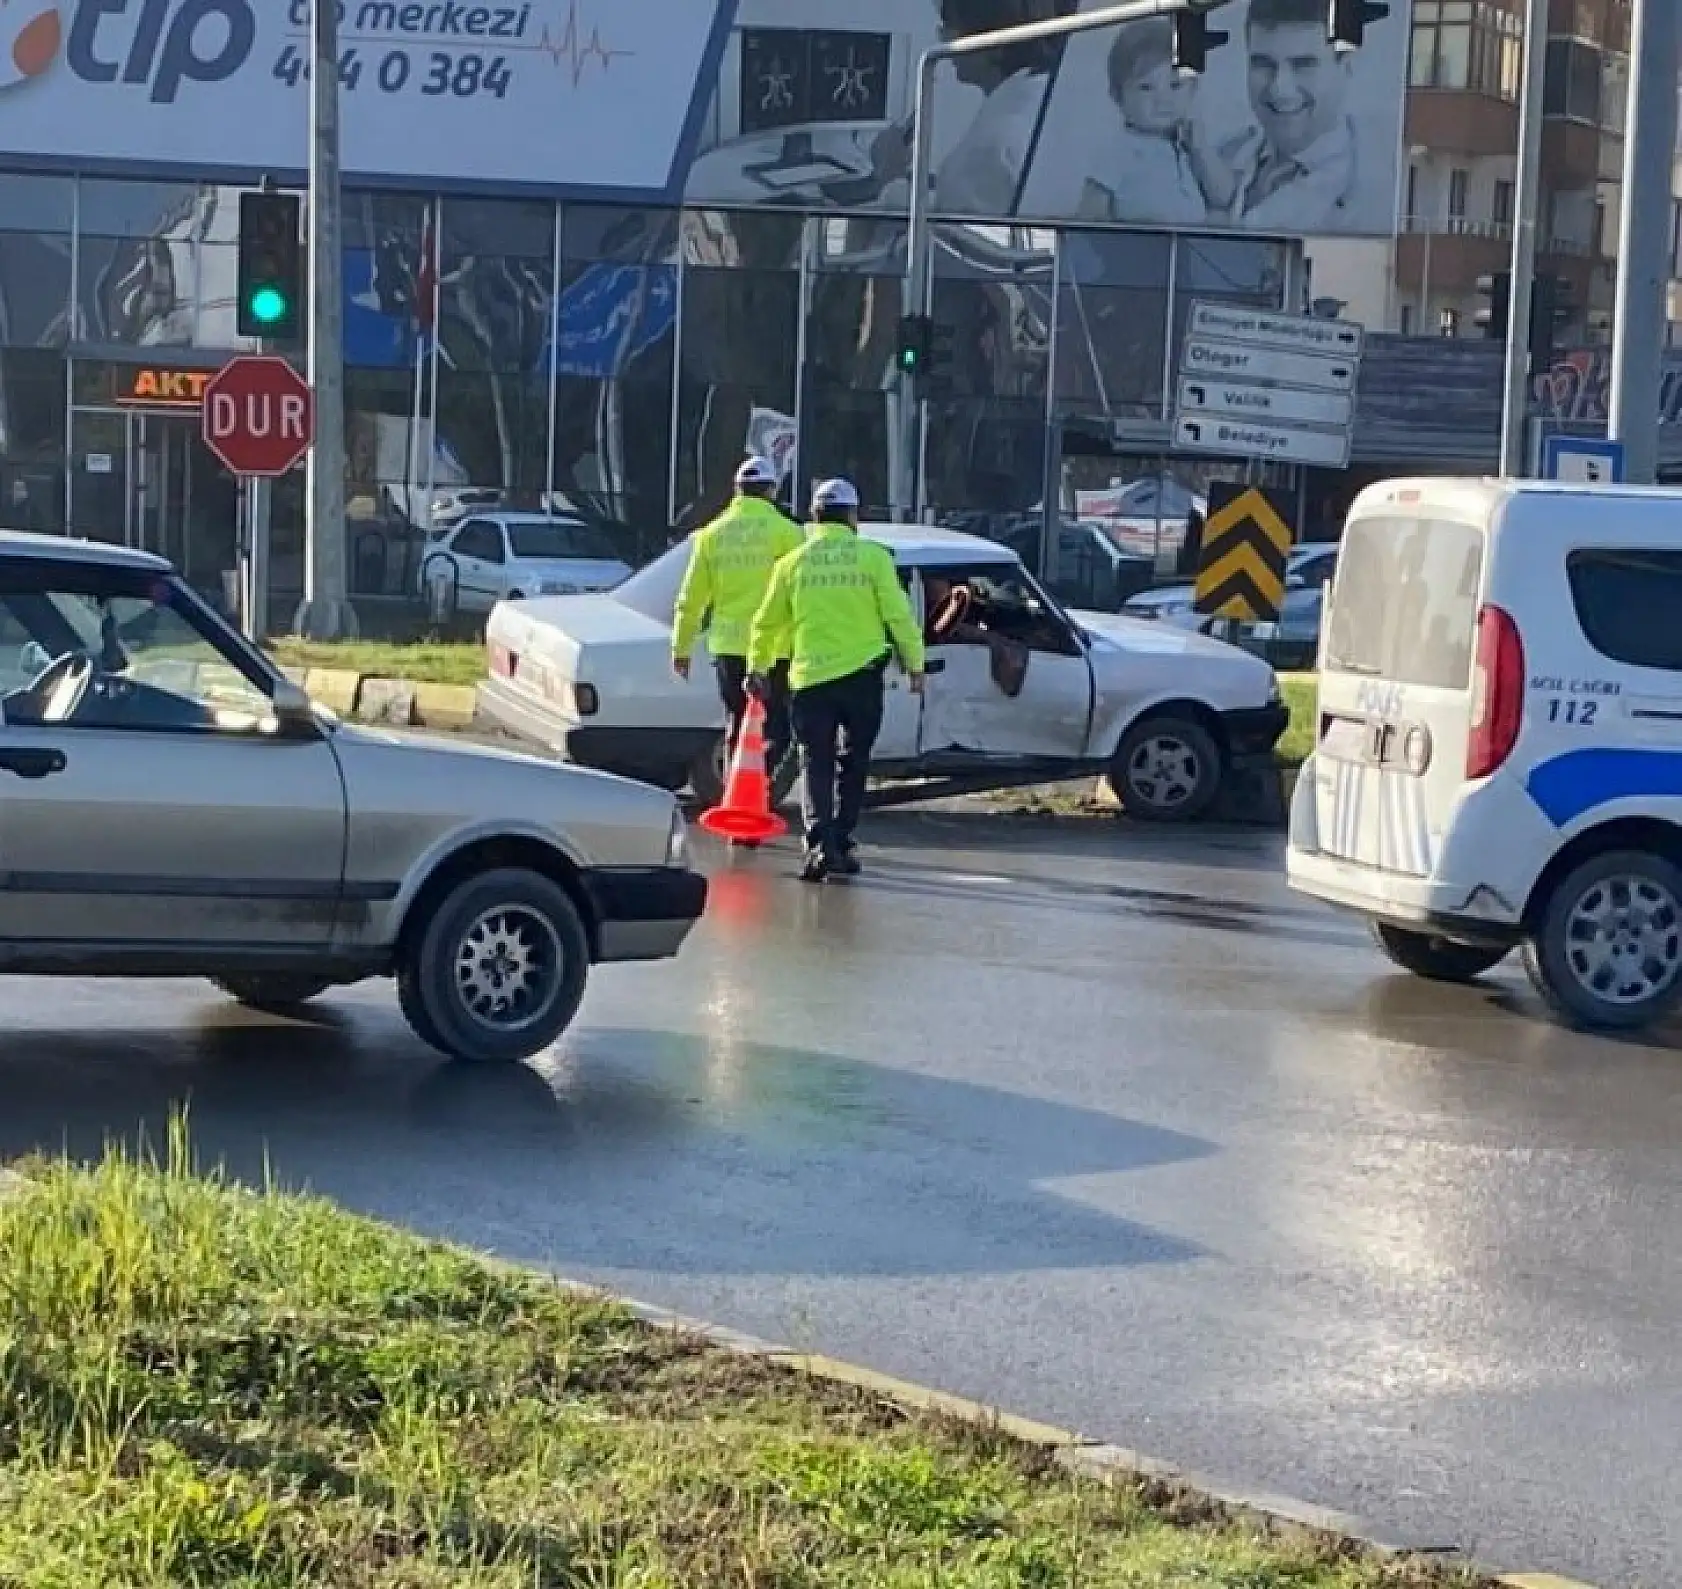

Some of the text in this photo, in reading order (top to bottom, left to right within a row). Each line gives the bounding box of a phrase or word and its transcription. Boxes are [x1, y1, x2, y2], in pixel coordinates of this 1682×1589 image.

[356, 0, 531, 37] merkezi
[272, 44, 512, 98] 44 0 384
[212, 393, 305, 438] DUR
[1548, 699, 1599, 726] 112
